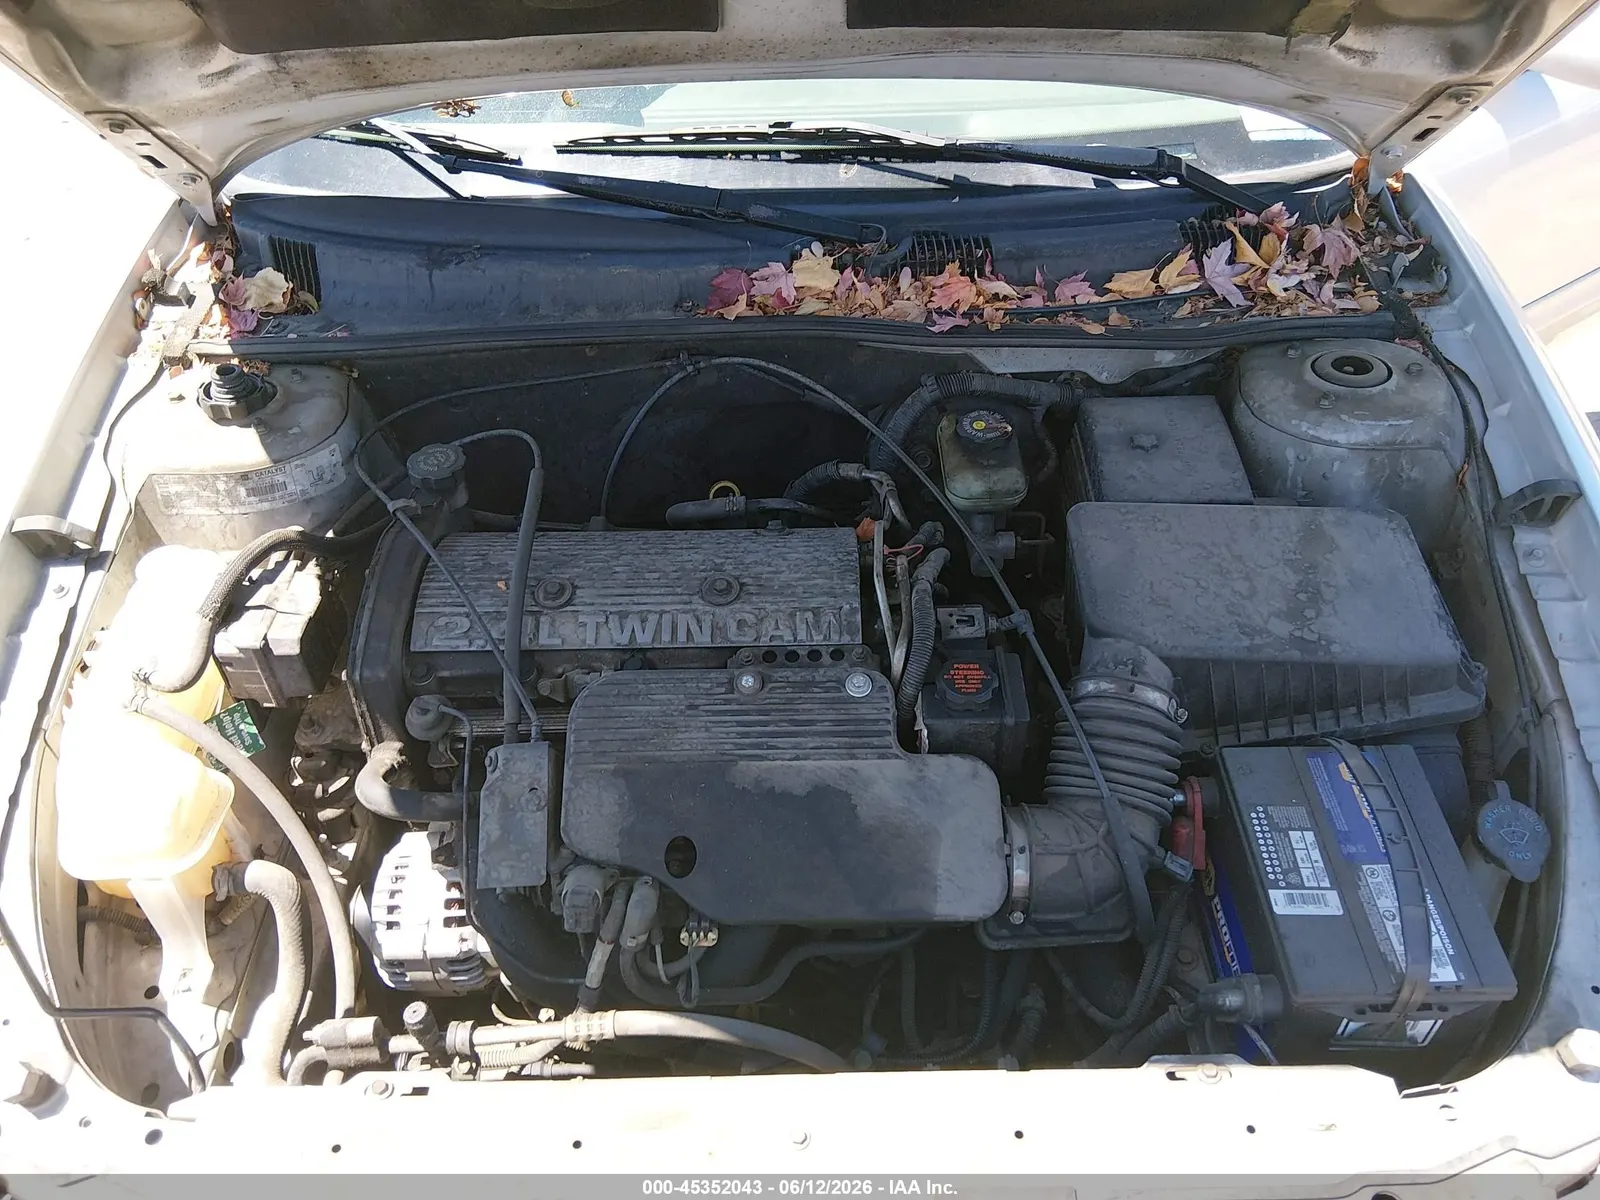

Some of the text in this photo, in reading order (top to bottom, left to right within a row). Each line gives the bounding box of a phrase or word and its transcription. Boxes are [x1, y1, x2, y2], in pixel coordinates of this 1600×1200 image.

[254, 466, 286, 477] CATALYST
[578, 611, 712, 646] TWIN
[727, 609, 842, 644] CAM
[220, 712, 236, 736] Help?
[1484, 804, 1511, 829] WASHER
[1519, 808, 1542, 832] FLUID
[1509, 850, 1532, 860] ONLY
